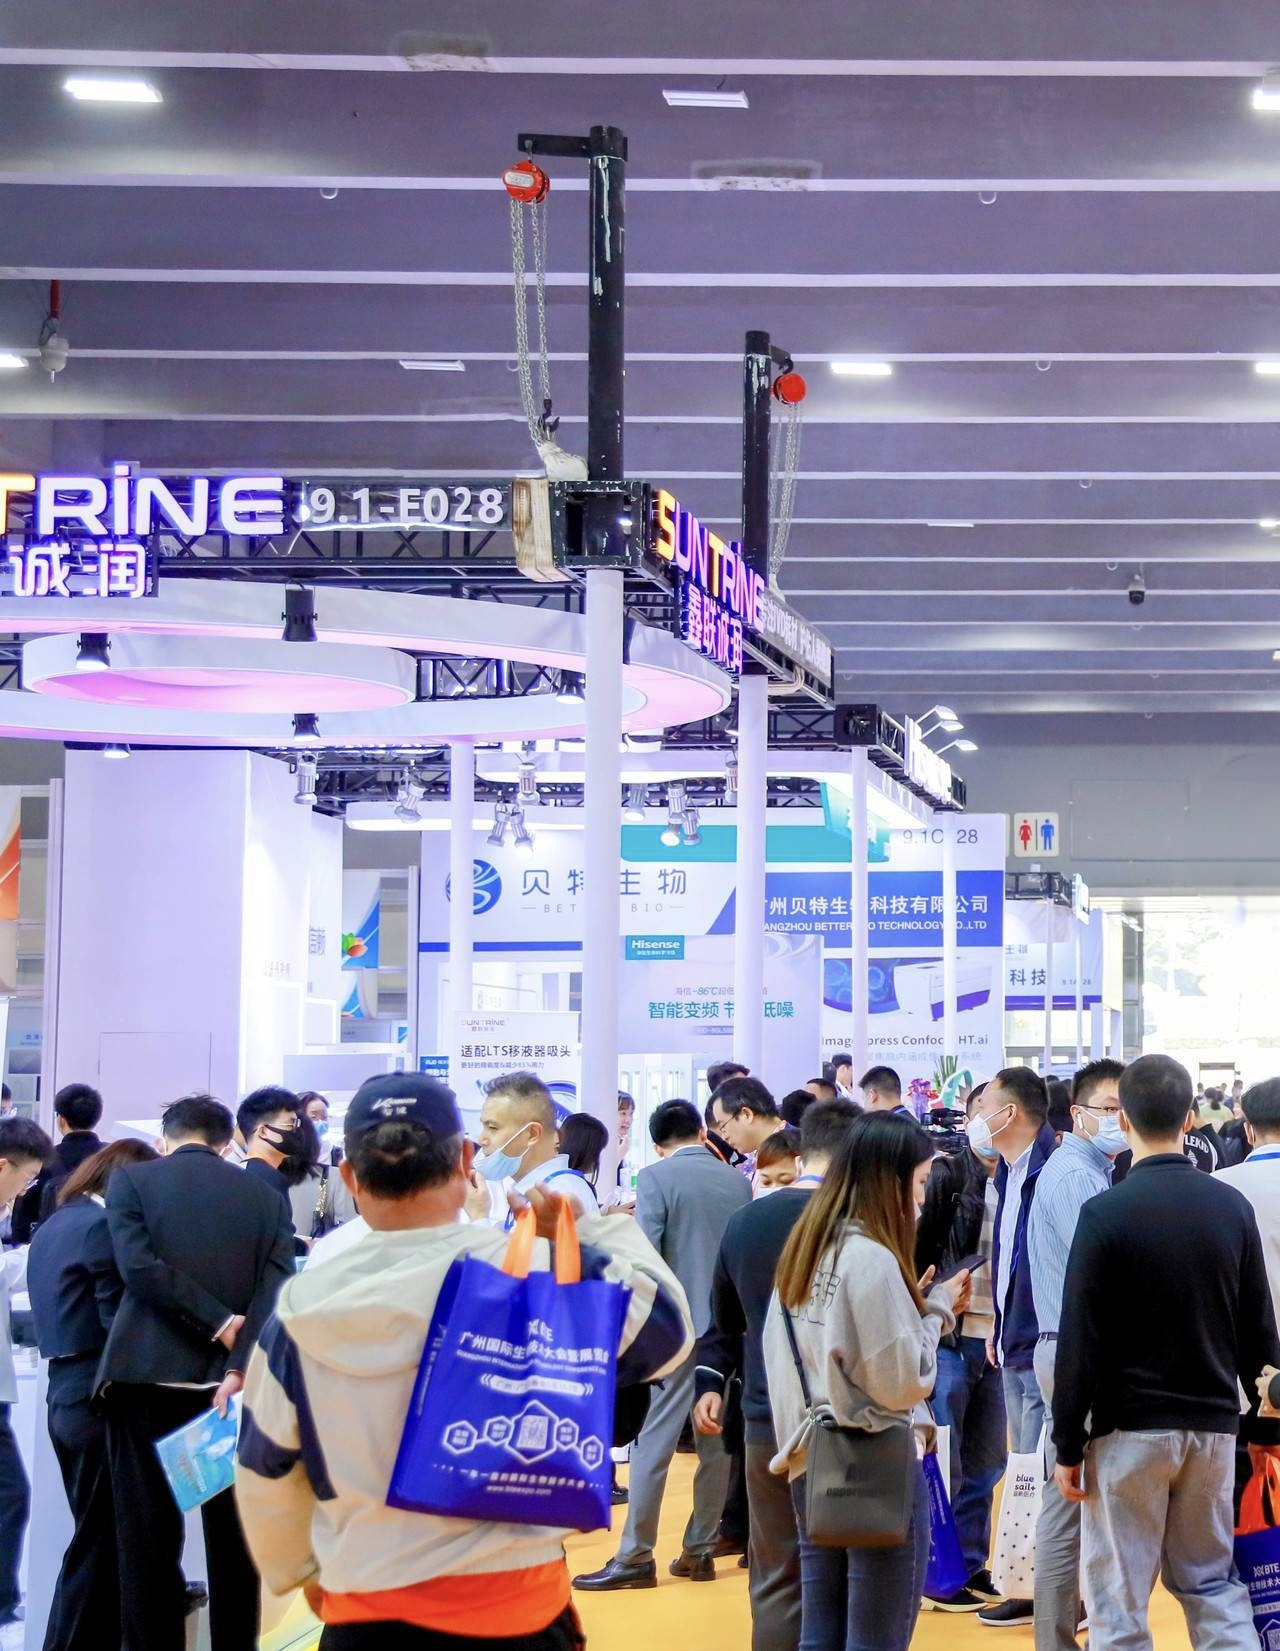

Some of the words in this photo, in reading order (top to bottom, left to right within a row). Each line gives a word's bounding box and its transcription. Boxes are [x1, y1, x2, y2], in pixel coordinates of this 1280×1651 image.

[310, 486, 504, 524] 9.1-E028
[9, 542, 147, 598] 诚润
[903, 828, 978, 845] 9.1C28
[631, 903, 664, 913] BIO
[763, 921, 812, 932] ANGZHOU
[878, 920, 944, 930] TECHNOLOGY
[955, 919, 988, 931] O.,LTD
[631, 939, 681, 949] Hisense
[1009, 968, 1047, 986] 科技
[648, 1000, 720, 1020] 智能变频
[902, 1034, 944, 1045] Confoc
[460, 1044, 571, 1058] 适配LTS移液器吸头
[1016, 1473, 1035, 1483] blue
[1014, 1482, 1031, 1491] sail
[1264, 1563, 1280, 1575] BTE
